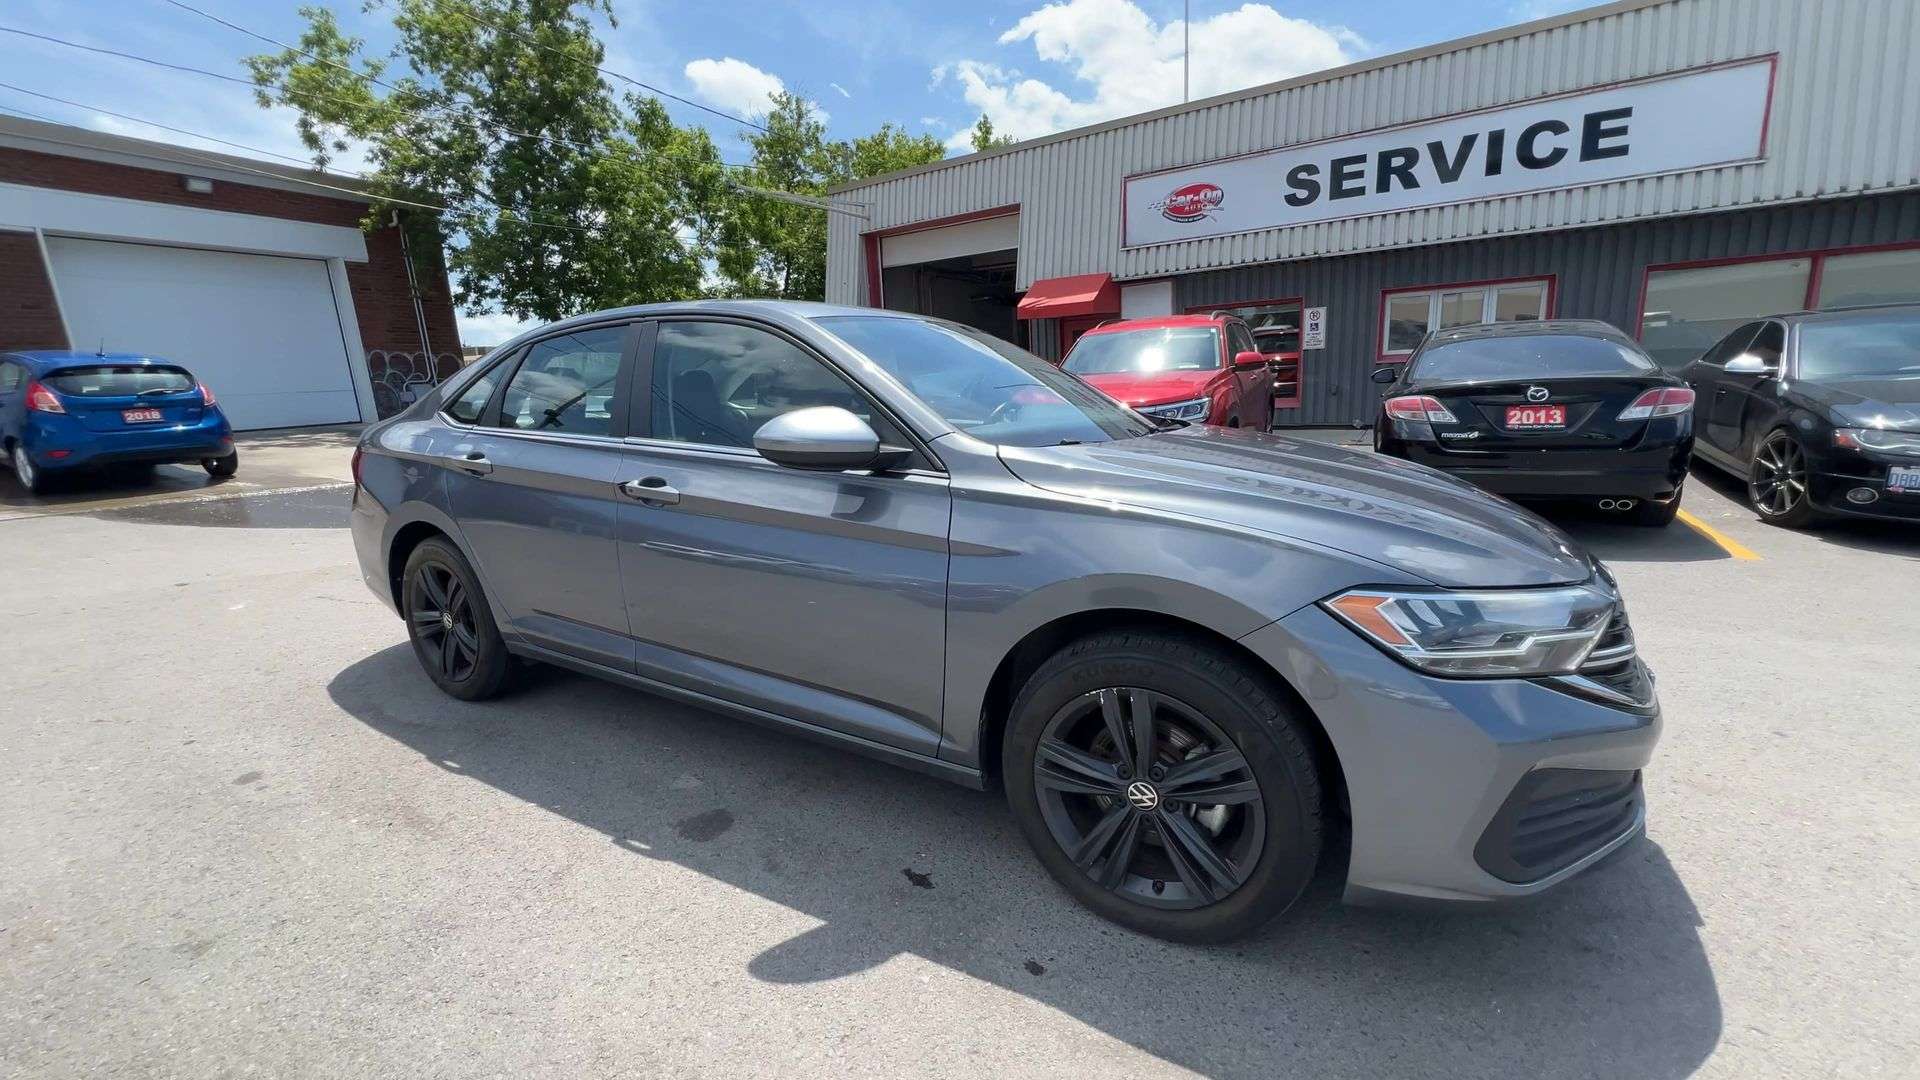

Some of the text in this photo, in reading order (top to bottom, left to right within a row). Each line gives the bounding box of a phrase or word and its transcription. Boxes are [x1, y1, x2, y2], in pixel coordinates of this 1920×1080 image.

[1284, 106, 1633, 207] SERVICE
[125, 411, 161, 420] 2018
[1507, 409, 1562, 424] 2013
